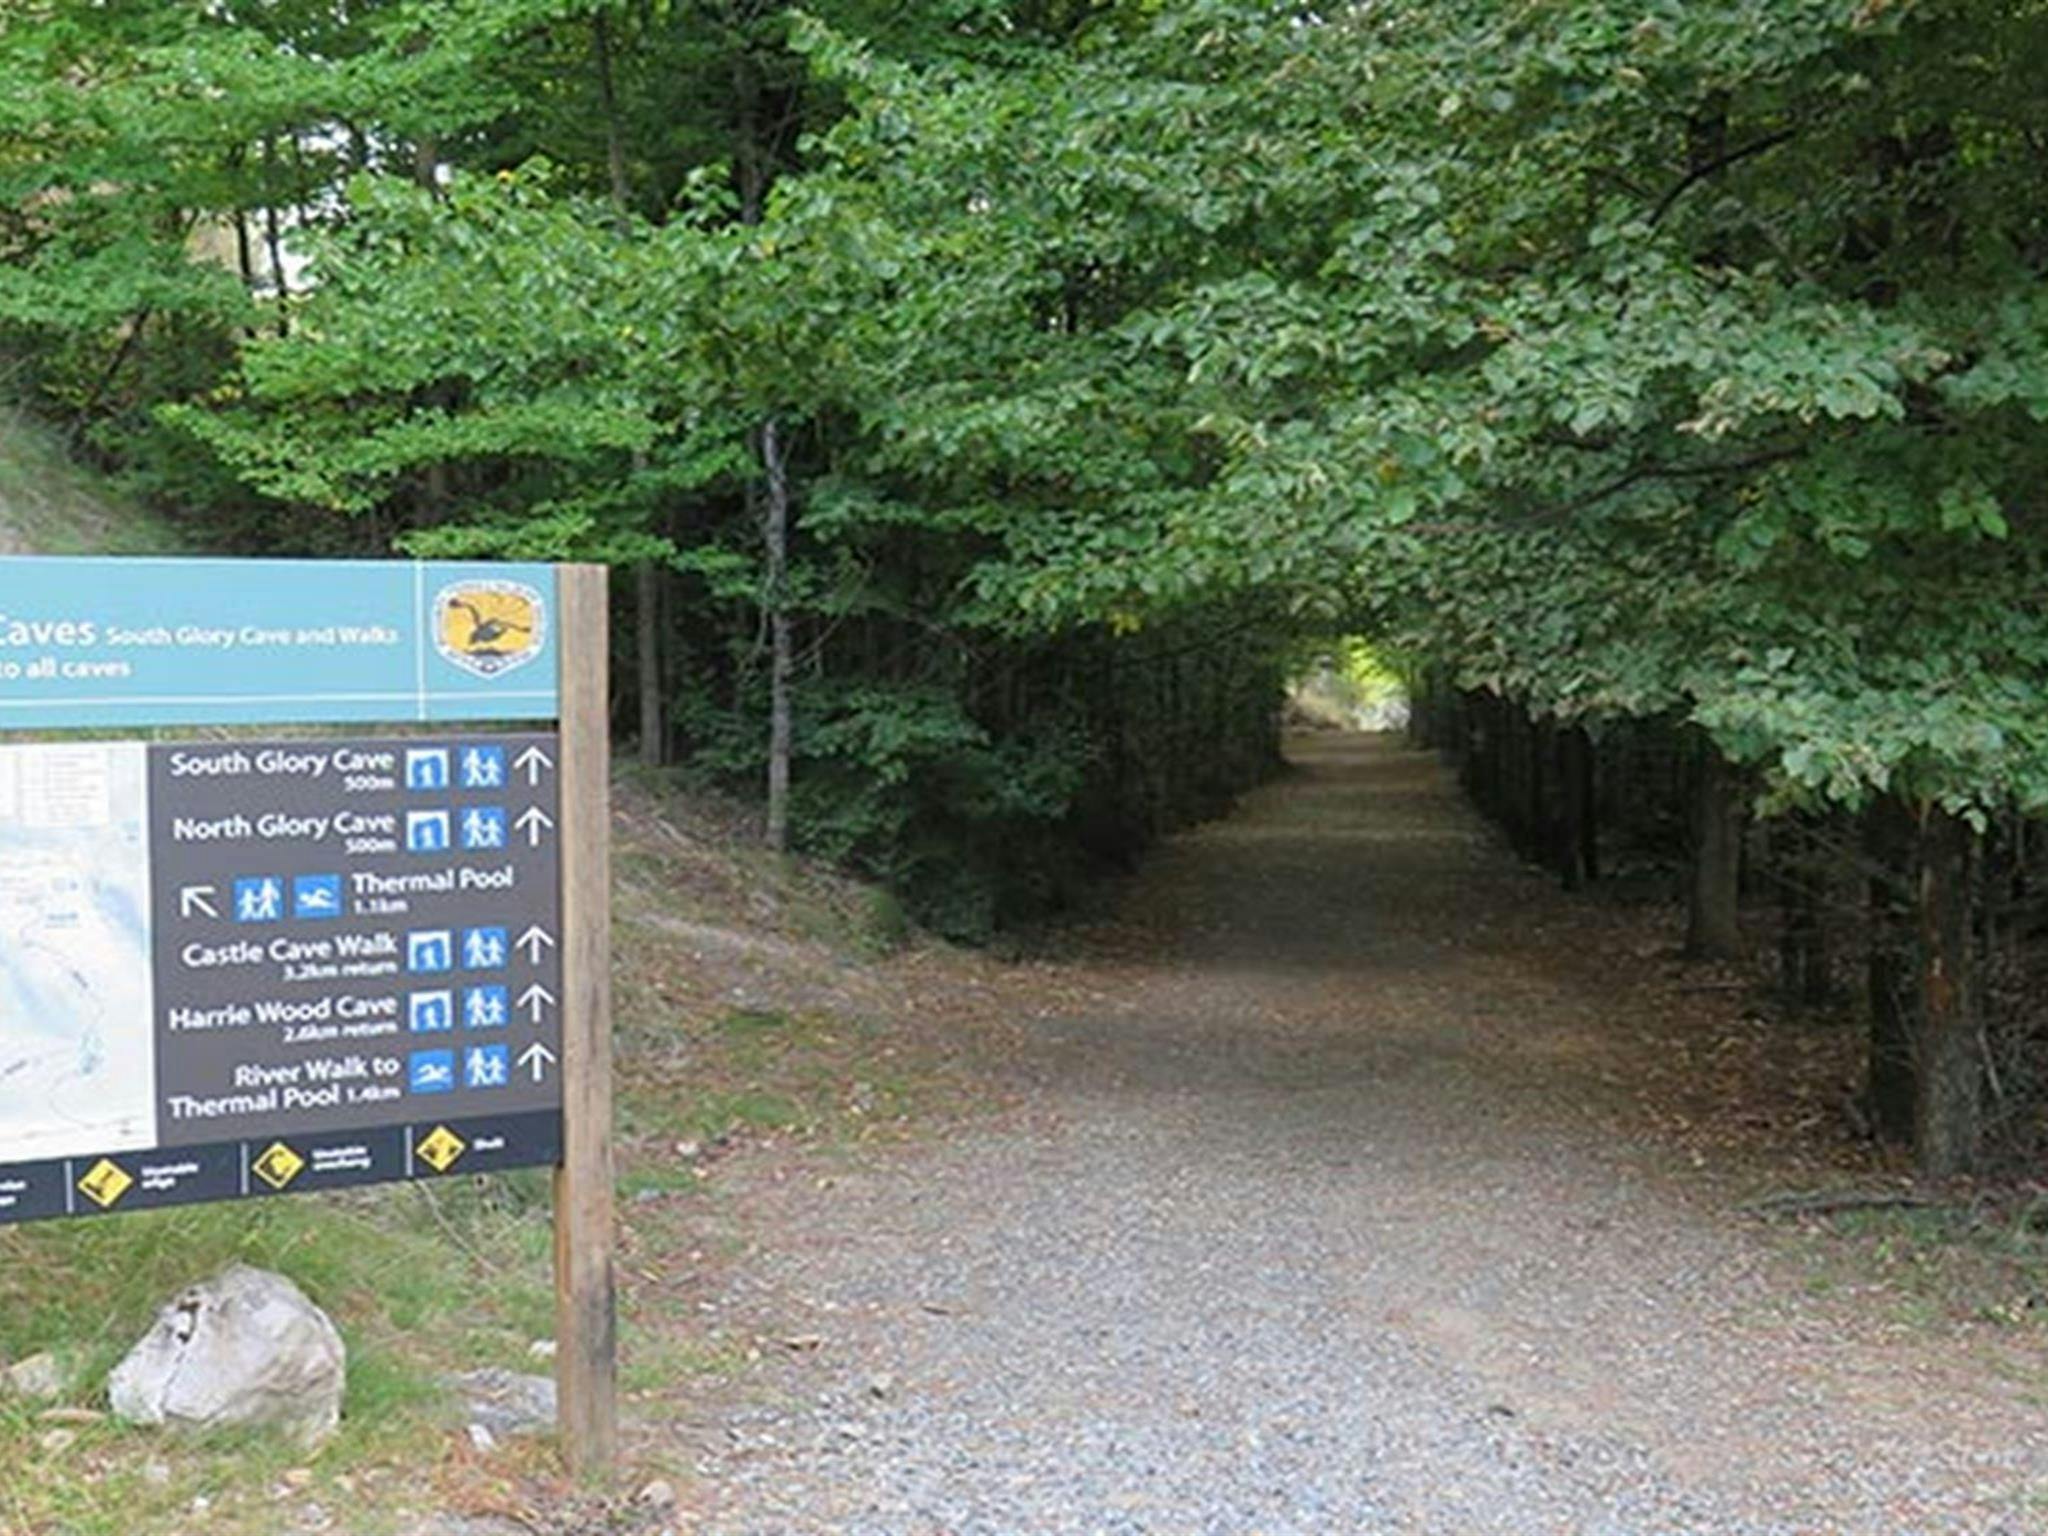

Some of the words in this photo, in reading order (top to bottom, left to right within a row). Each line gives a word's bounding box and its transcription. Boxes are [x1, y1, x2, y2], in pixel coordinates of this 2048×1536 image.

[105, 626, 171, 645] South
[175, 626, 235, 649] Glory
[239, 626, 295, 645] Cave
[297, 626, 336, 645] and
[338, 626, 398, 645] Walks
[26, 655, 56, 679] all
[61, 660, 131, 678] caves
[170, 751, 250, 777] South
[255, 750, 328, 778] Glory
[332, 749, 395, 772] Cave
[344, 775, 396, 791] 500m
[173, 814, 251, 840] North
[257, 814, 329, 841] Glory
[333, 811, 395, 834] Cave
[345, 839, 397, 855] 500m
[352, 865, 454, 894] Thermal
[459, 864, 514, 889] Pool
[182, 940, 264, 968] Castle
[269, 936, 332, 961] Cave
[334, 931, 398, 957] Walk
[341, 961, 398, 977] return
[169, 1002, 252, 1030] Harrie
[254, 996, 331, 1023] Wood
[336, 995, 398, 1018] Cave
[341, 1020, 398, 1037] return
[234, 1064, 301, 1087] River
[304, 1055, 368, 1081] Walk
[372, 1057, 400, 1076] to
[169, 1088, 277, 1119] Thermal
[283, 1083, 340, 1109] Pool
